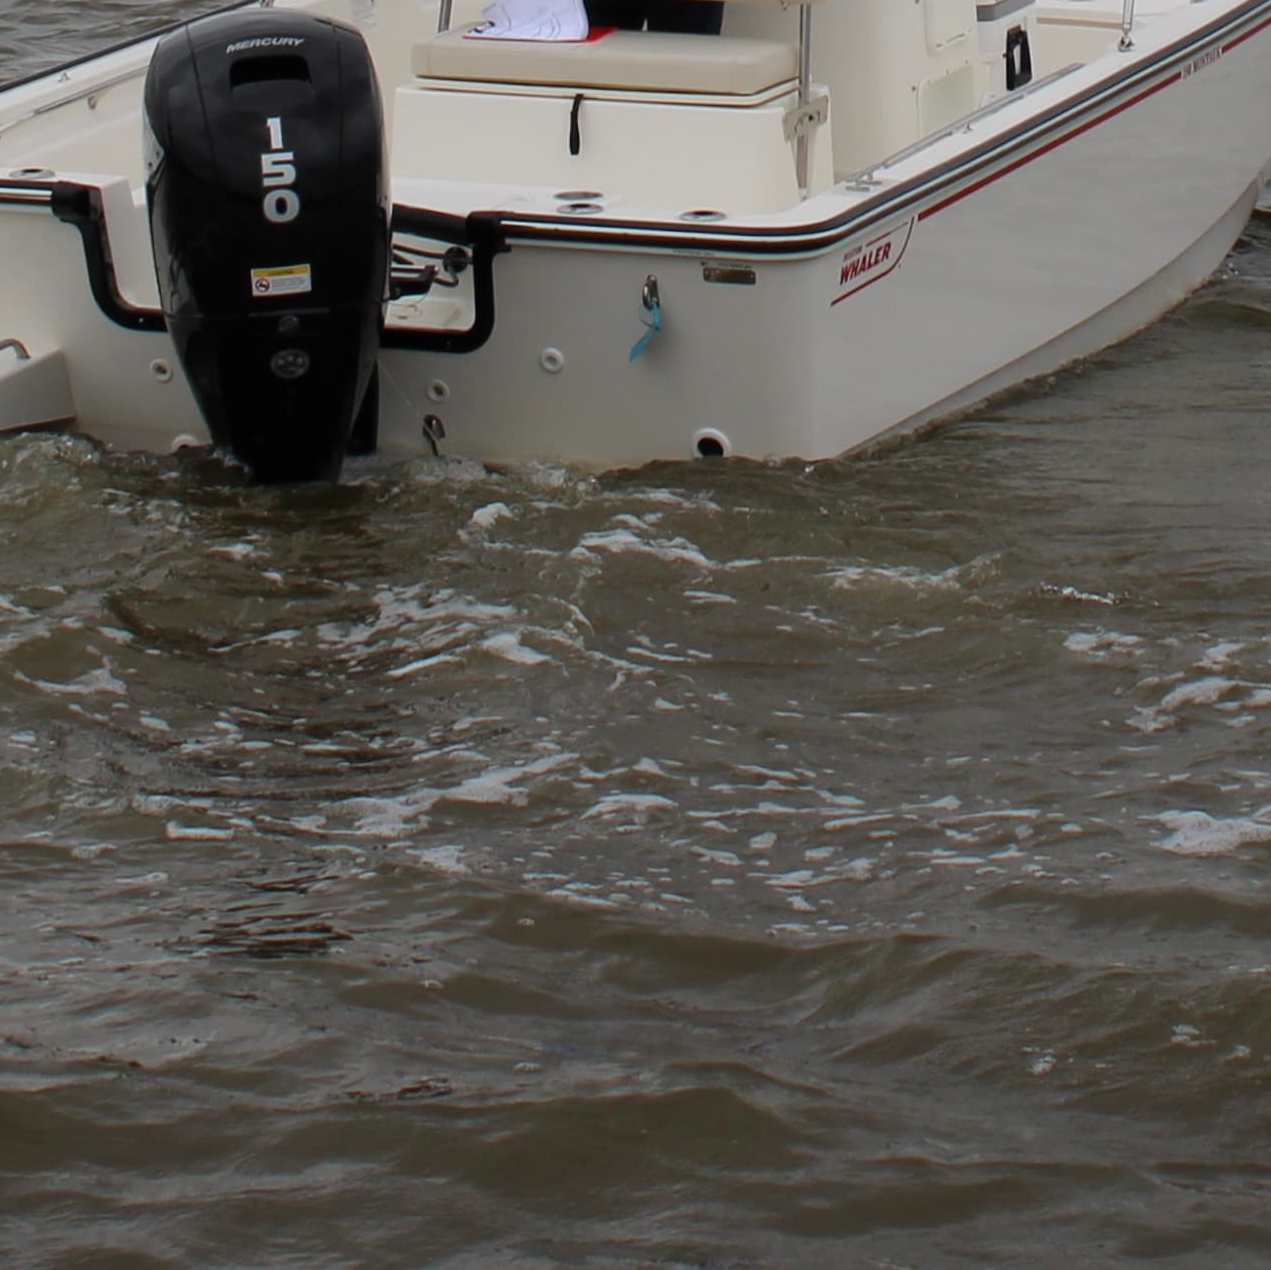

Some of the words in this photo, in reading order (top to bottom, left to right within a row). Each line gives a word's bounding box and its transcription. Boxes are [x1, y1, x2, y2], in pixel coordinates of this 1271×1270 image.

[225, 36, 305, 54] MERCURY
[260, 116, 301, 224] 150
[840, 241, 892, 286] WHALER
